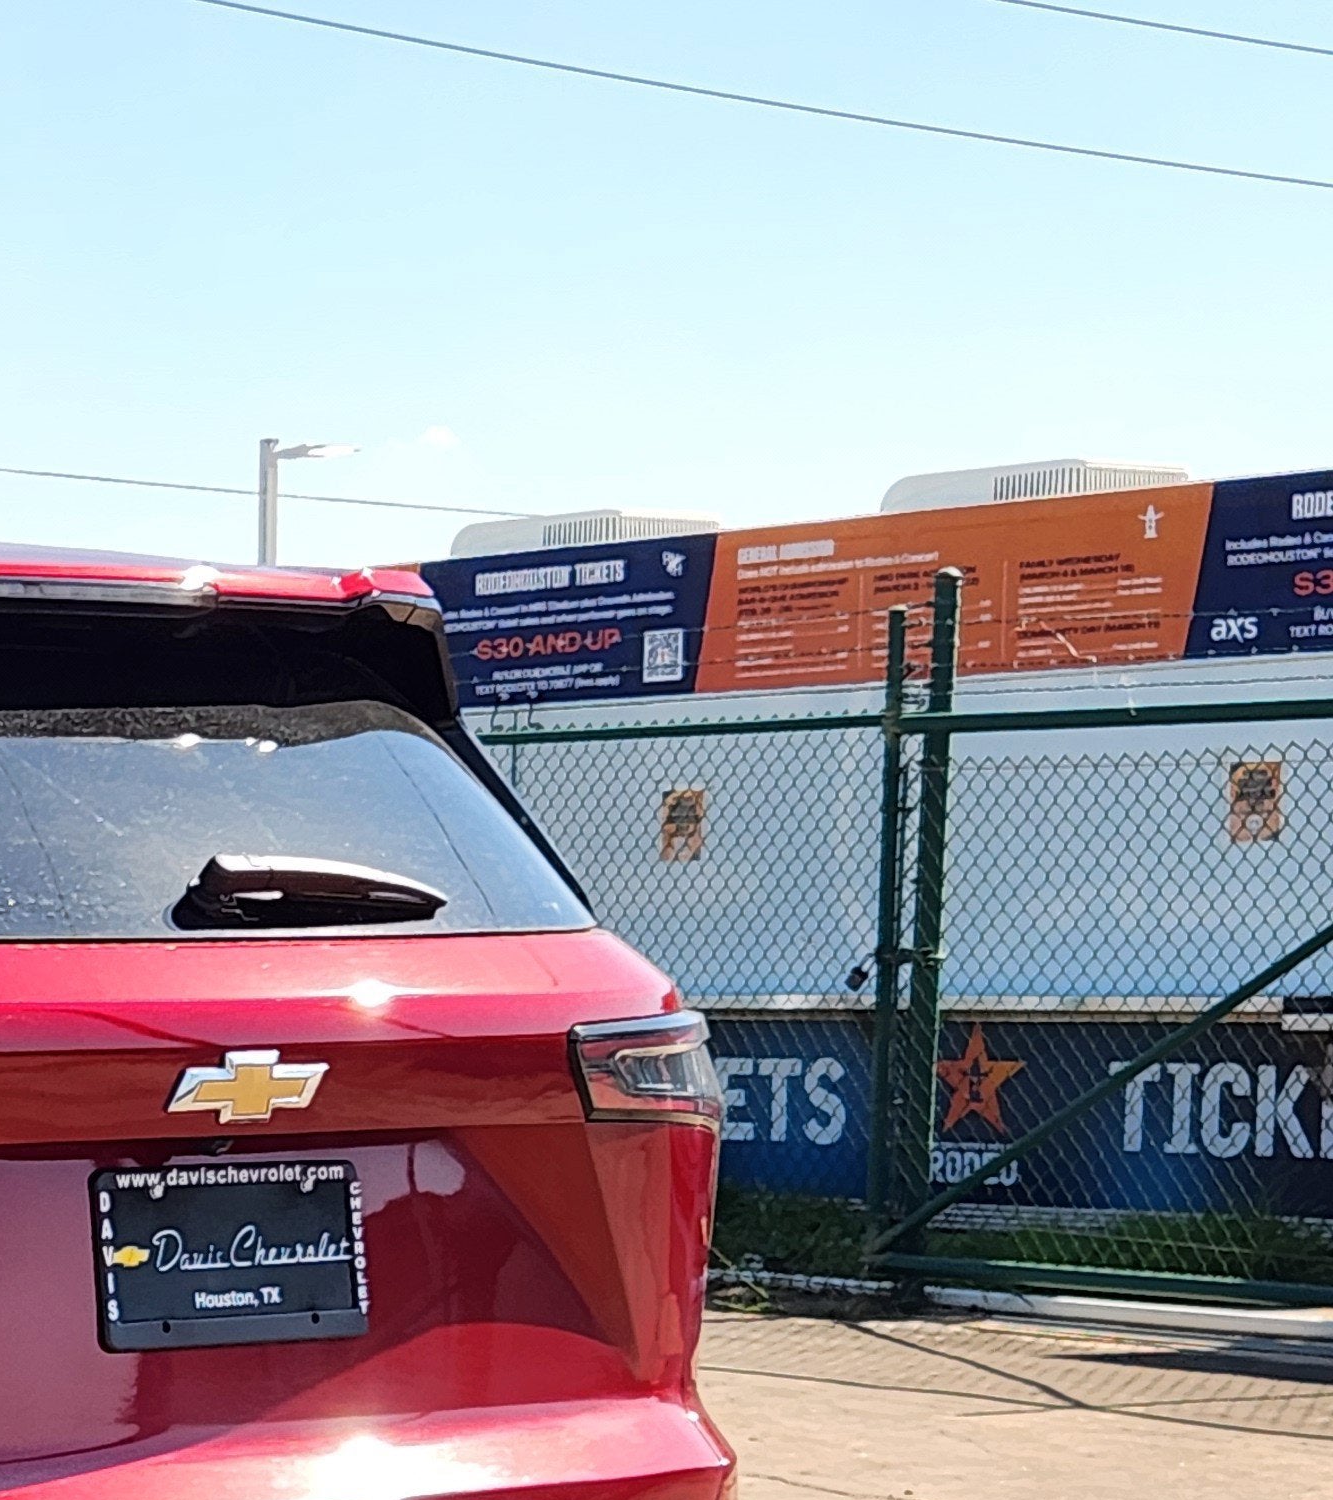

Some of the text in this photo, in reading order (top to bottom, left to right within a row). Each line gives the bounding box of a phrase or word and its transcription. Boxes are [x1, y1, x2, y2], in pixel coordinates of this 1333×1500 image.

[1210, 616, 1258, 643] axs
[116, 1165, 344, 1189] www.davischevrolet.com
[99, 1190, 120, 1322] DAVIS
[230, 1224, 353, 1267] Chevrolet
[349, 1181, 368, 1315] CHEVROLET
[194, 1286, 282, 1310] Houston, TX
